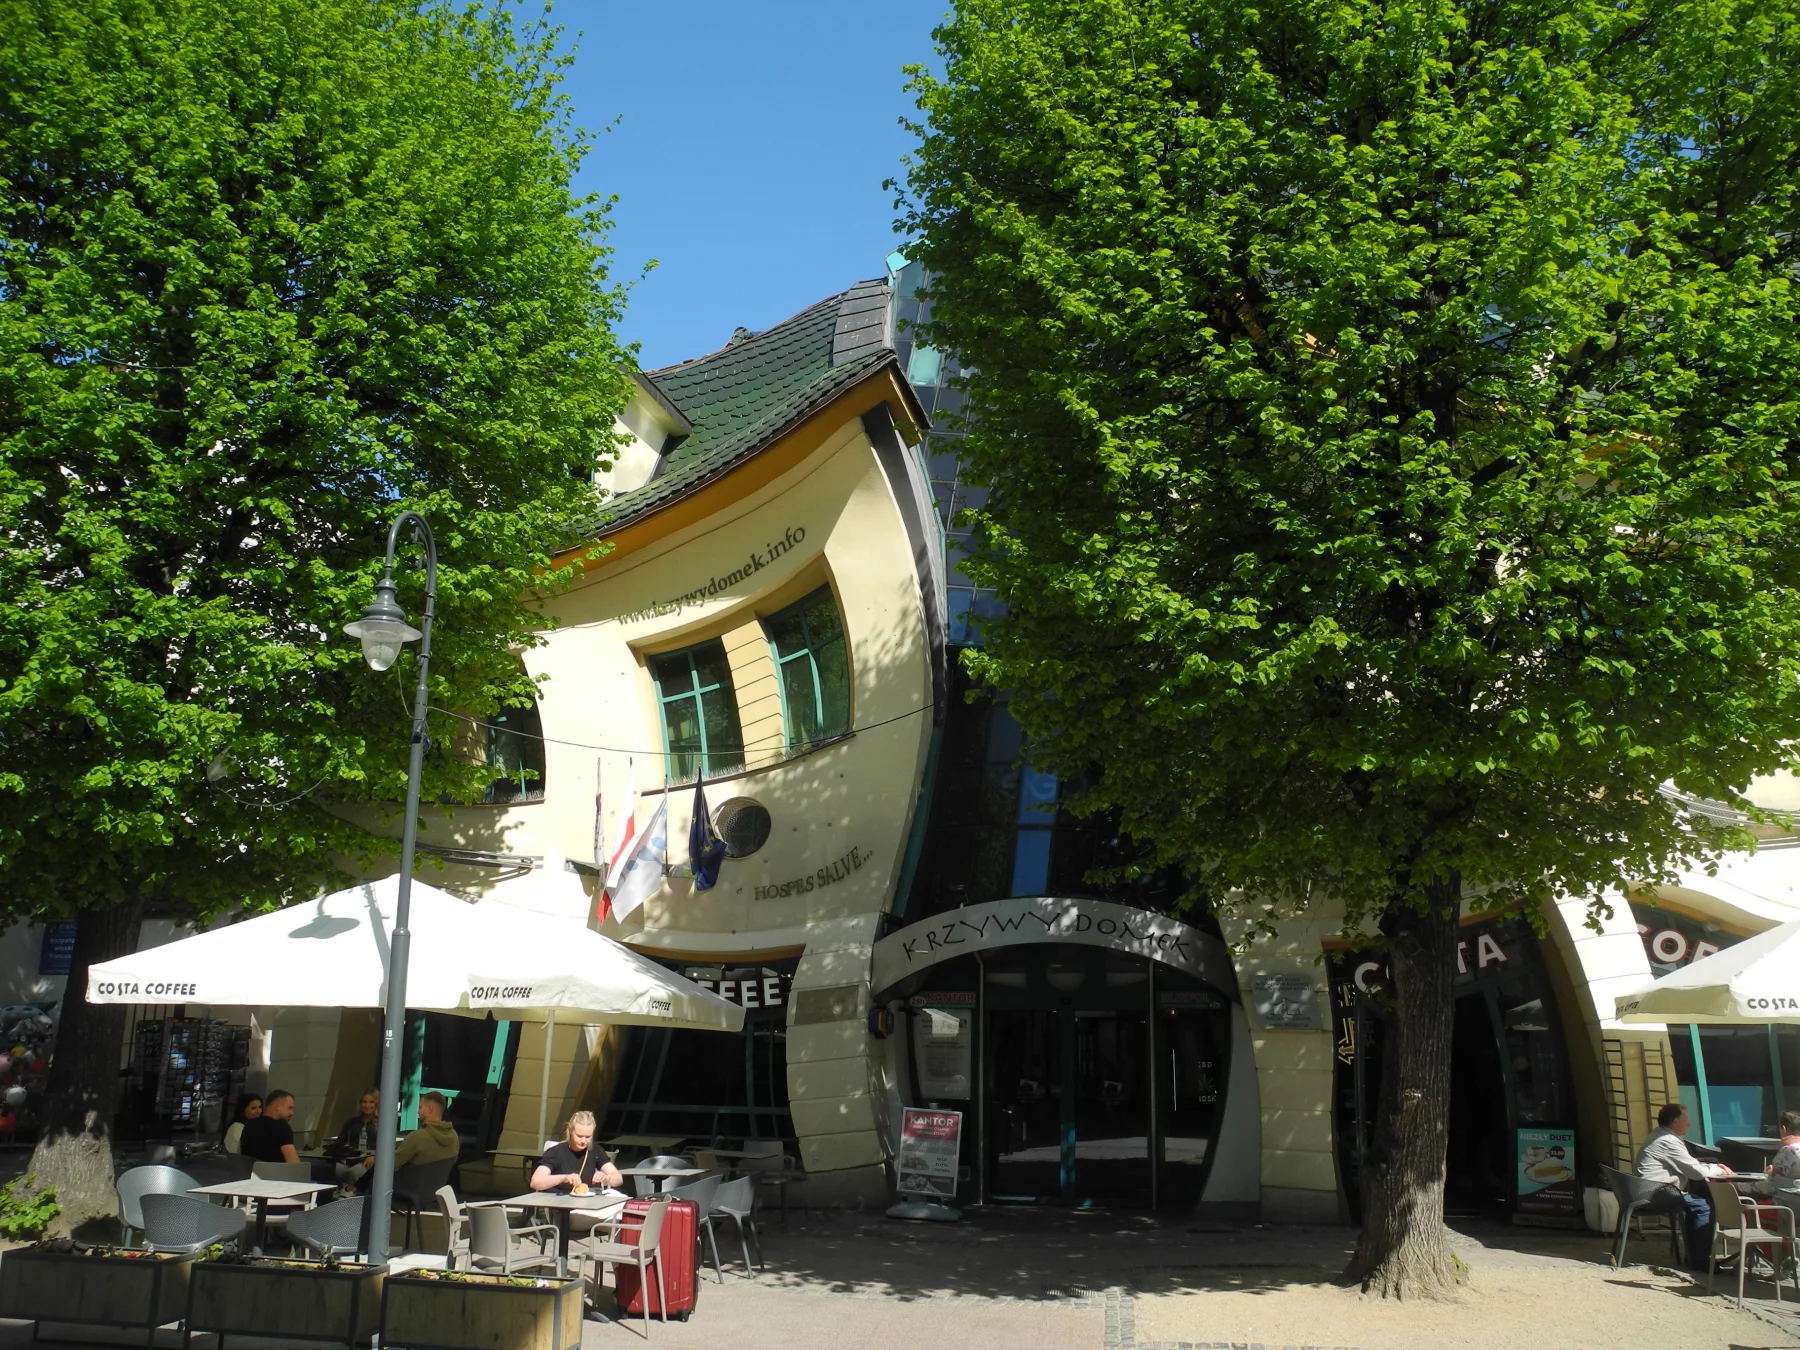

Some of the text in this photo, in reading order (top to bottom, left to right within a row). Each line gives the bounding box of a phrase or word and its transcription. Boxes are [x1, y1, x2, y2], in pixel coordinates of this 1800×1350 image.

[617, 527, 806, 626] www.krzywydomek.info
[754, 876, 814, 900] HOSPES
[903, 911, 1189, 962] KRZYWY DOMEK
[98, 983, 197, 996] COSTA COFFEE
[471, 986, 533, 1000] COSTA COFFEE
[927, 993, 975, 1003] KANTOR
[1747, 998, 1799, 1010] COSTA
[651, 1000, 672, 1011] COFFEE
[911, 1115, 954, 1127] KANTOR
[1520, 1133, 1573, 1142] NIEZŁY DUET
